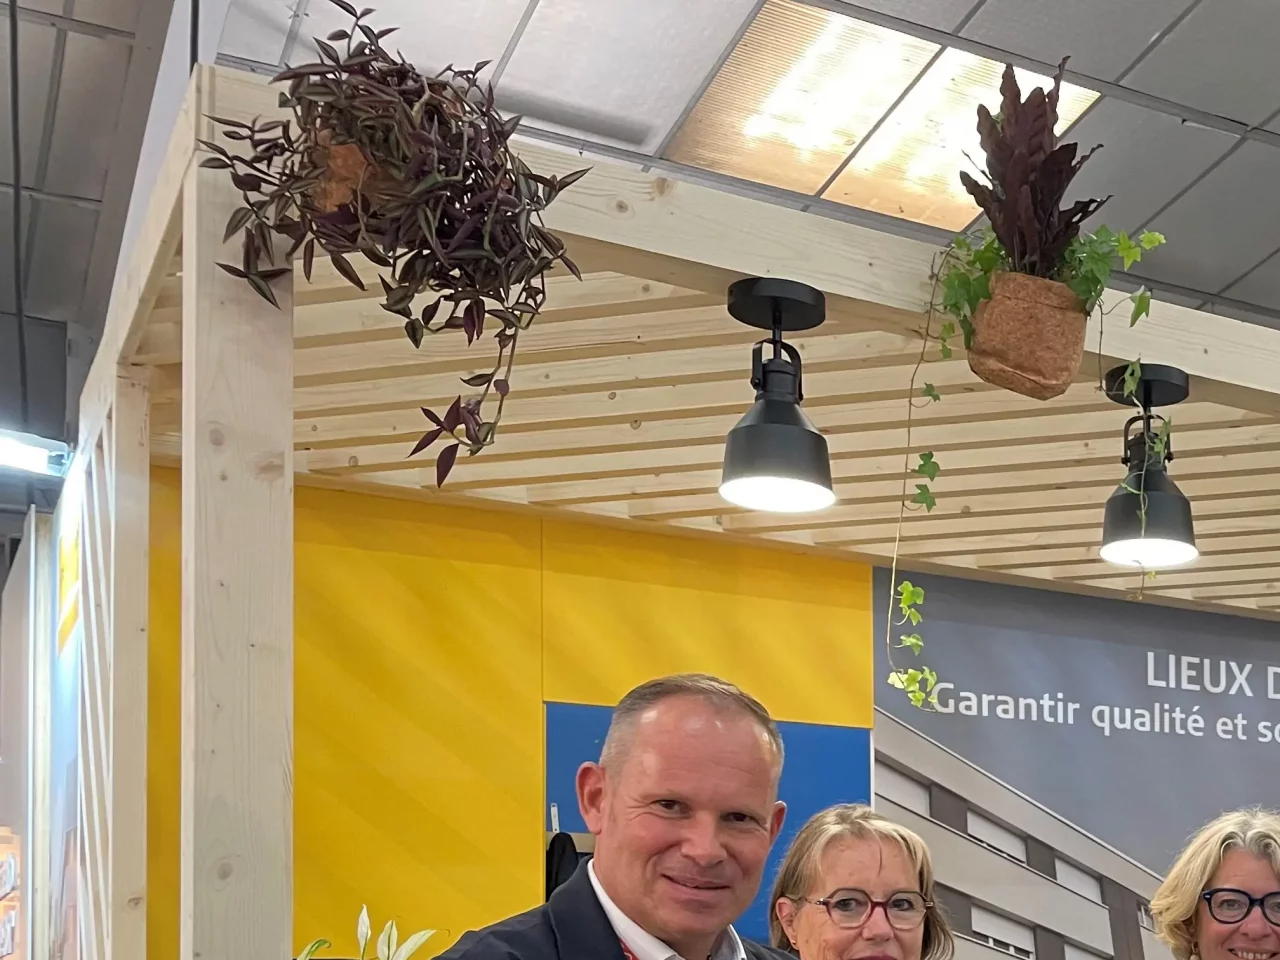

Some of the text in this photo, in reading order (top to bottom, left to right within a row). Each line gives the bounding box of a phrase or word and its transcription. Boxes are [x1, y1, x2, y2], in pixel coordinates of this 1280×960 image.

[1146, 651, 1254, 697] LIEUX
[931, 682, 1081, 725] Garantir
[1091, 702, 1205, 737] qualité
[1216, 713, 1247, 741] et
